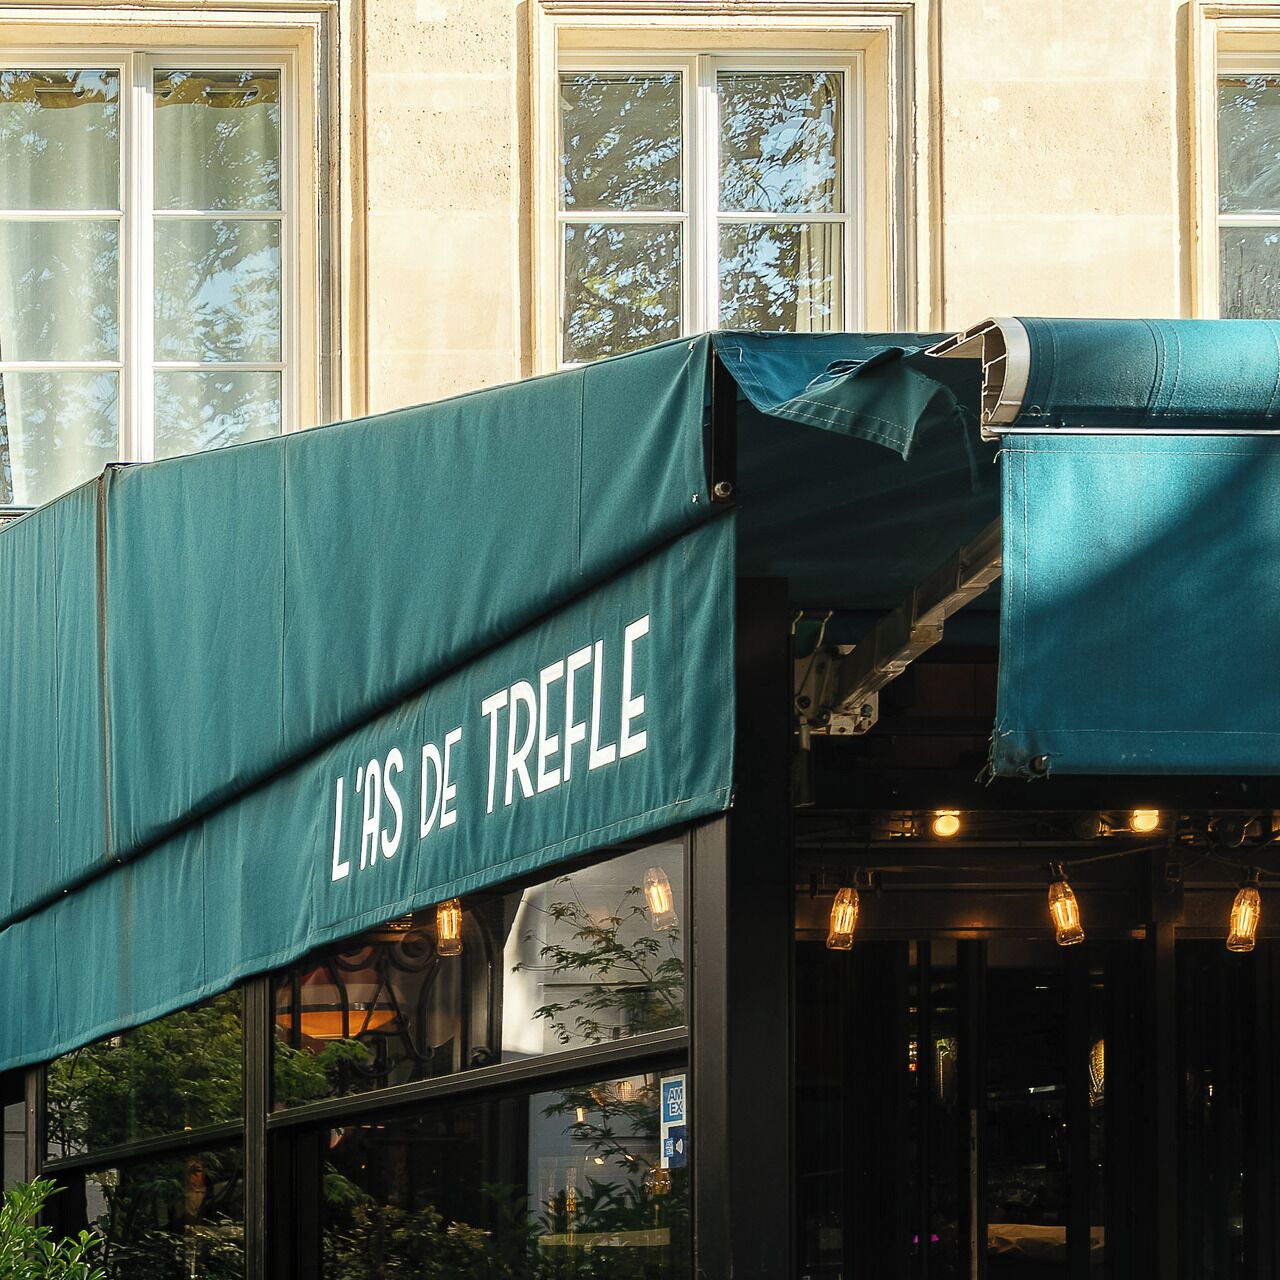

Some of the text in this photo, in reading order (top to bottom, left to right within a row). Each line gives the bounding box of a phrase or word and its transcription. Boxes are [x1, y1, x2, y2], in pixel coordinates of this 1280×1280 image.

[331, 613, 650, 882] L'AS DE TREFLE
[668, 1087, 683, 1103] AM
[670, 1102, 683, 1115] EX
